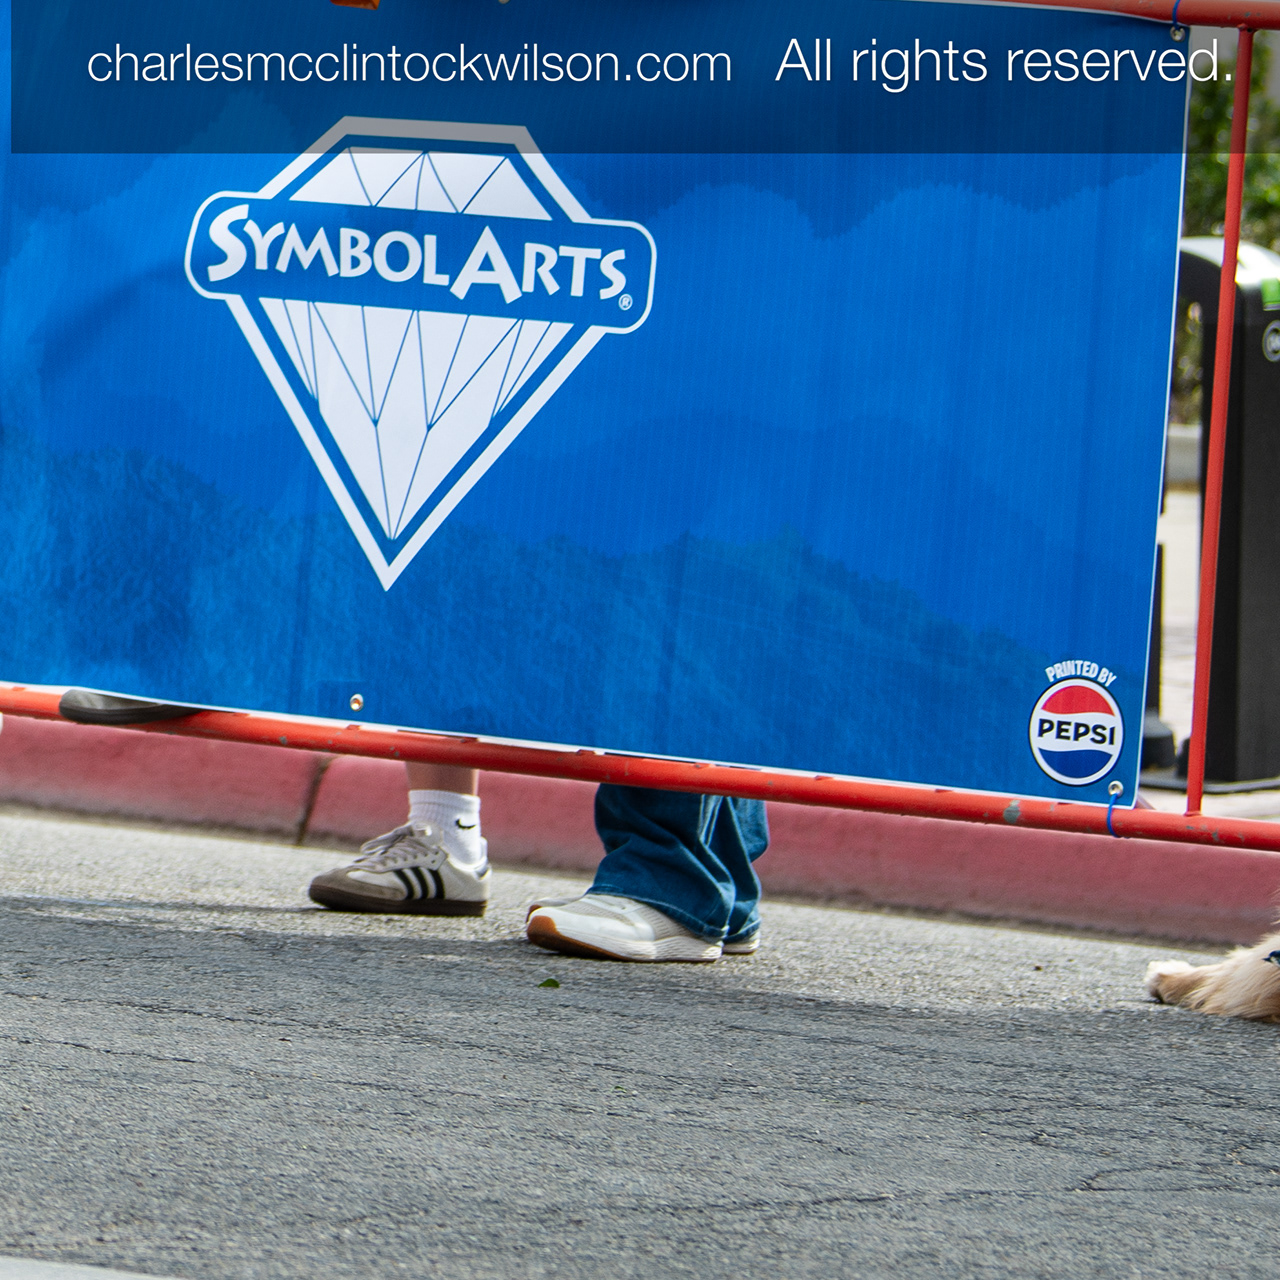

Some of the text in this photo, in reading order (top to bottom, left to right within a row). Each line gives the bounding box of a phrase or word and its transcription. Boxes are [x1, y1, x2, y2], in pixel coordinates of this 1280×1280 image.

[1044, 659, 1118, 687] PRINTED BY
[1037, 717, 1116, 746] PEPSI
